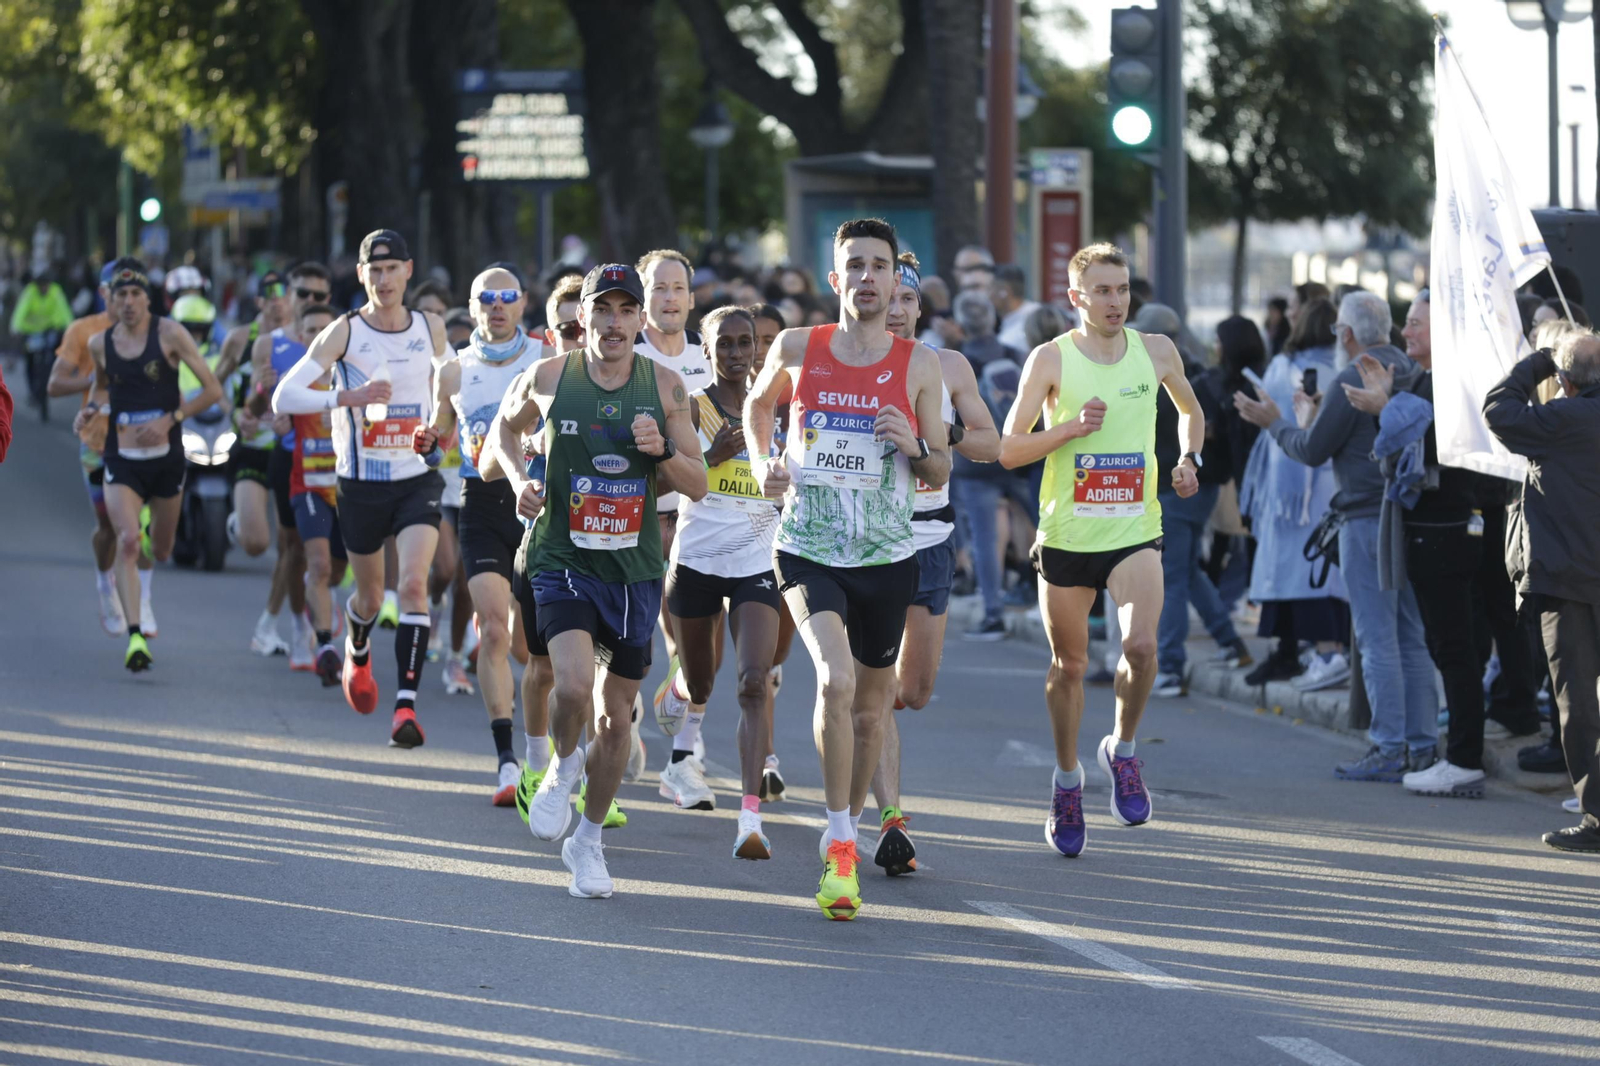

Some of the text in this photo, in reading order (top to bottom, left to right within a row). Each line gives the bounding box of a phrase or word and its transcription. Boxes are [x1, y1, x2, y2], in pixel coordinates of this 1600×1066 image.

[818, 391, 879, 409] SEVILLA
[832, 417, 875, 430] ZURICH
[590, 424, 630, 441] FILA
[373, 435, 413, 446] JULIEN
[836, 439, 849, 450] 57
[816, 452, 865, 471] PACER
[1100, 457, 1138, 466] ZURICH
[1102, 475, 1119, 485] 574
[596, 482, 637, 494] ZURICH
[718, 478, 763, 497] DALILA
[1085, 488, 1134, 502] ADRIEN
[598, 503, 616, 514] 562
[583, 516, 629, 533] PAPINI
